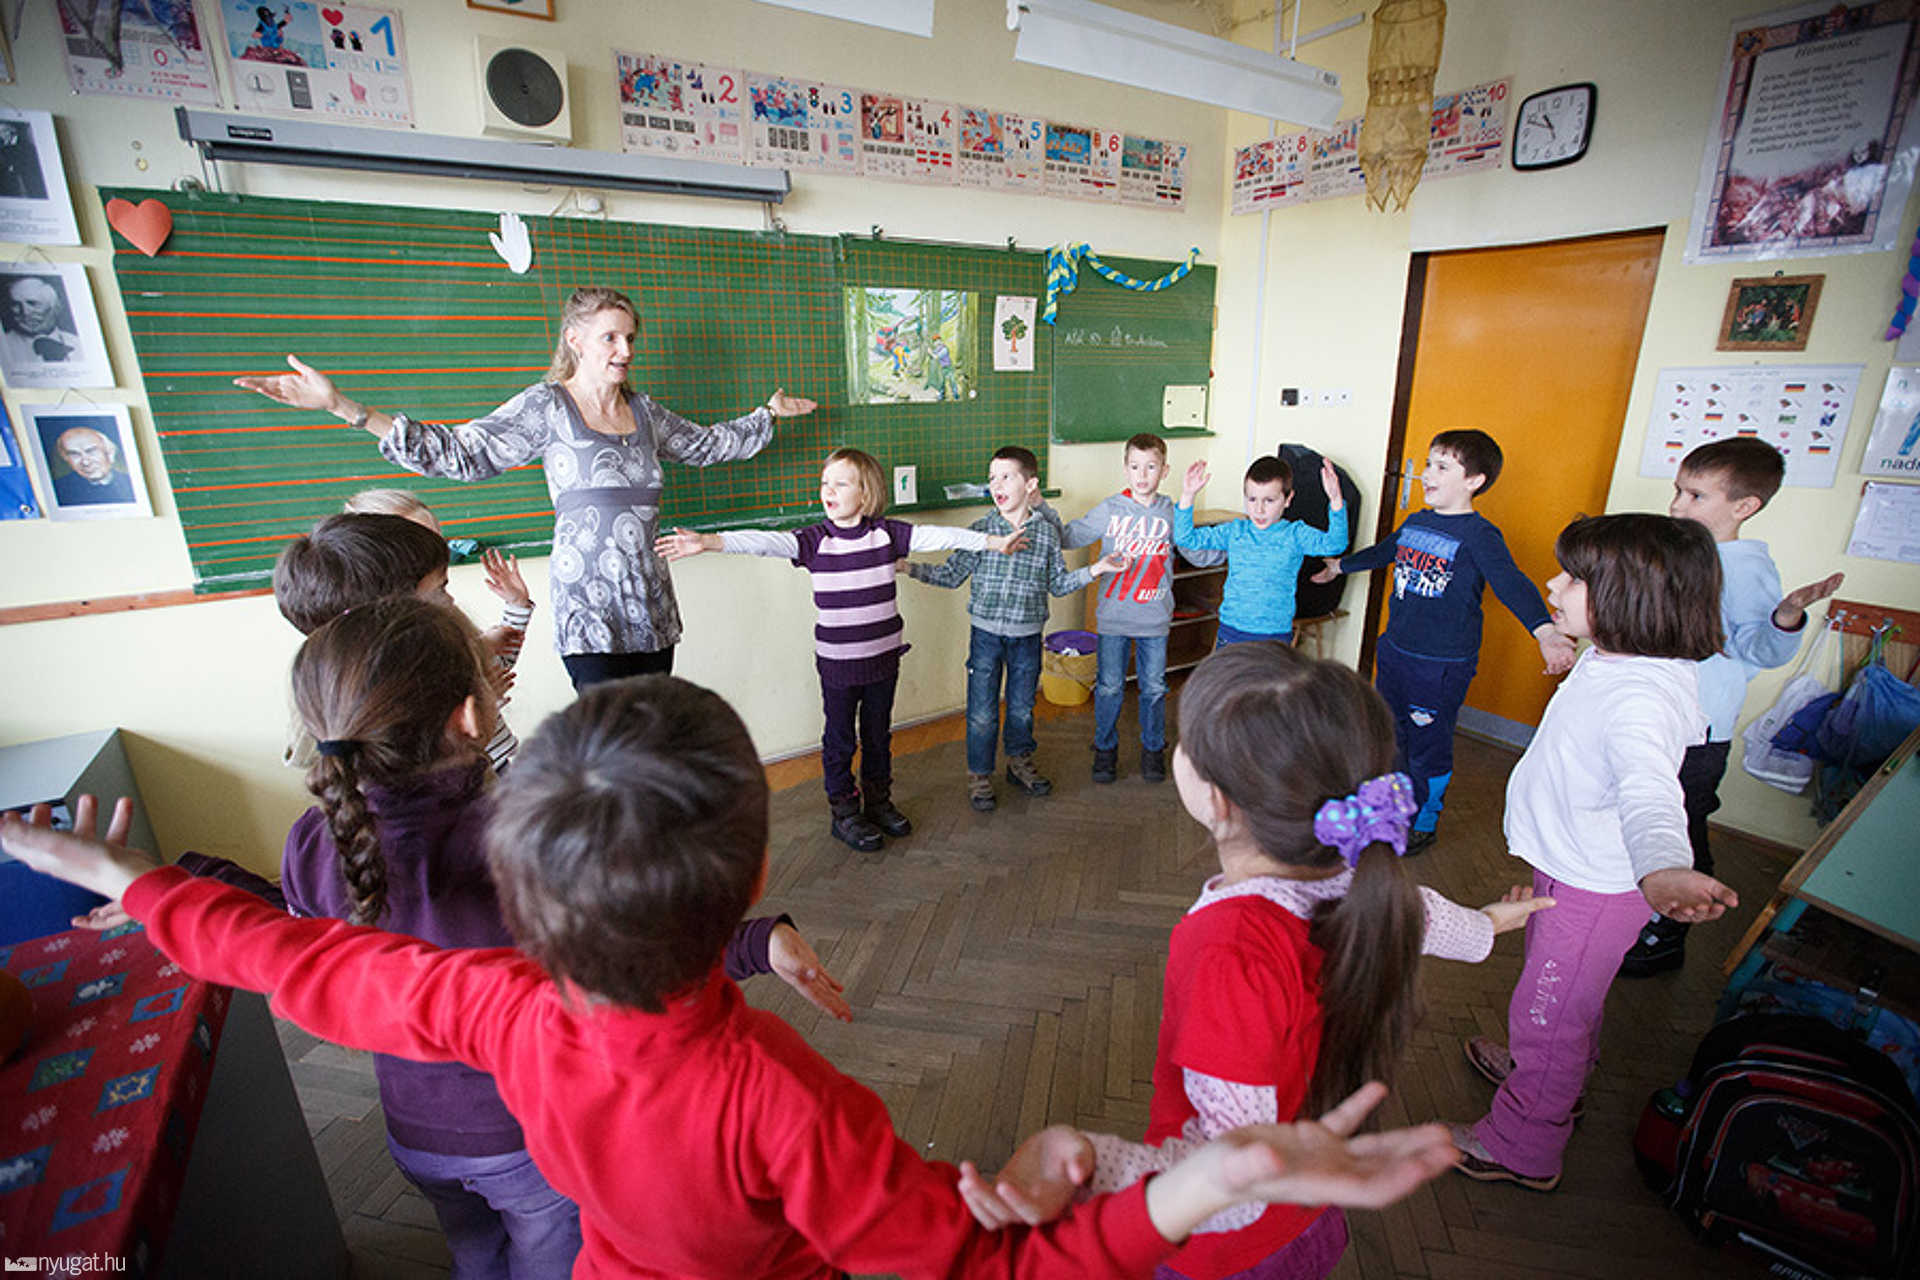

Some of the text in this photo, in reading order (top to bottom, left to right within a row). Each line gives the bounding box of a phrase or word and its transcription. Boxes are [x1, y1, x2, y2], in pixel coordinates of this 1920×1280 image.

[370, 15, 396, 57] 1
[718, 74, 738, 103] 2
[1487, 83, 1506, 103] 10
[840, 91, 853, 114] 3
[941, 109, 952, 128] 4
[1030, 121, 1041, 141] 5
[1109, 134, 1119, 153] 6
[1297, 136, 1306, 152] 8
[1105, 515, 1170, 539] MAD
